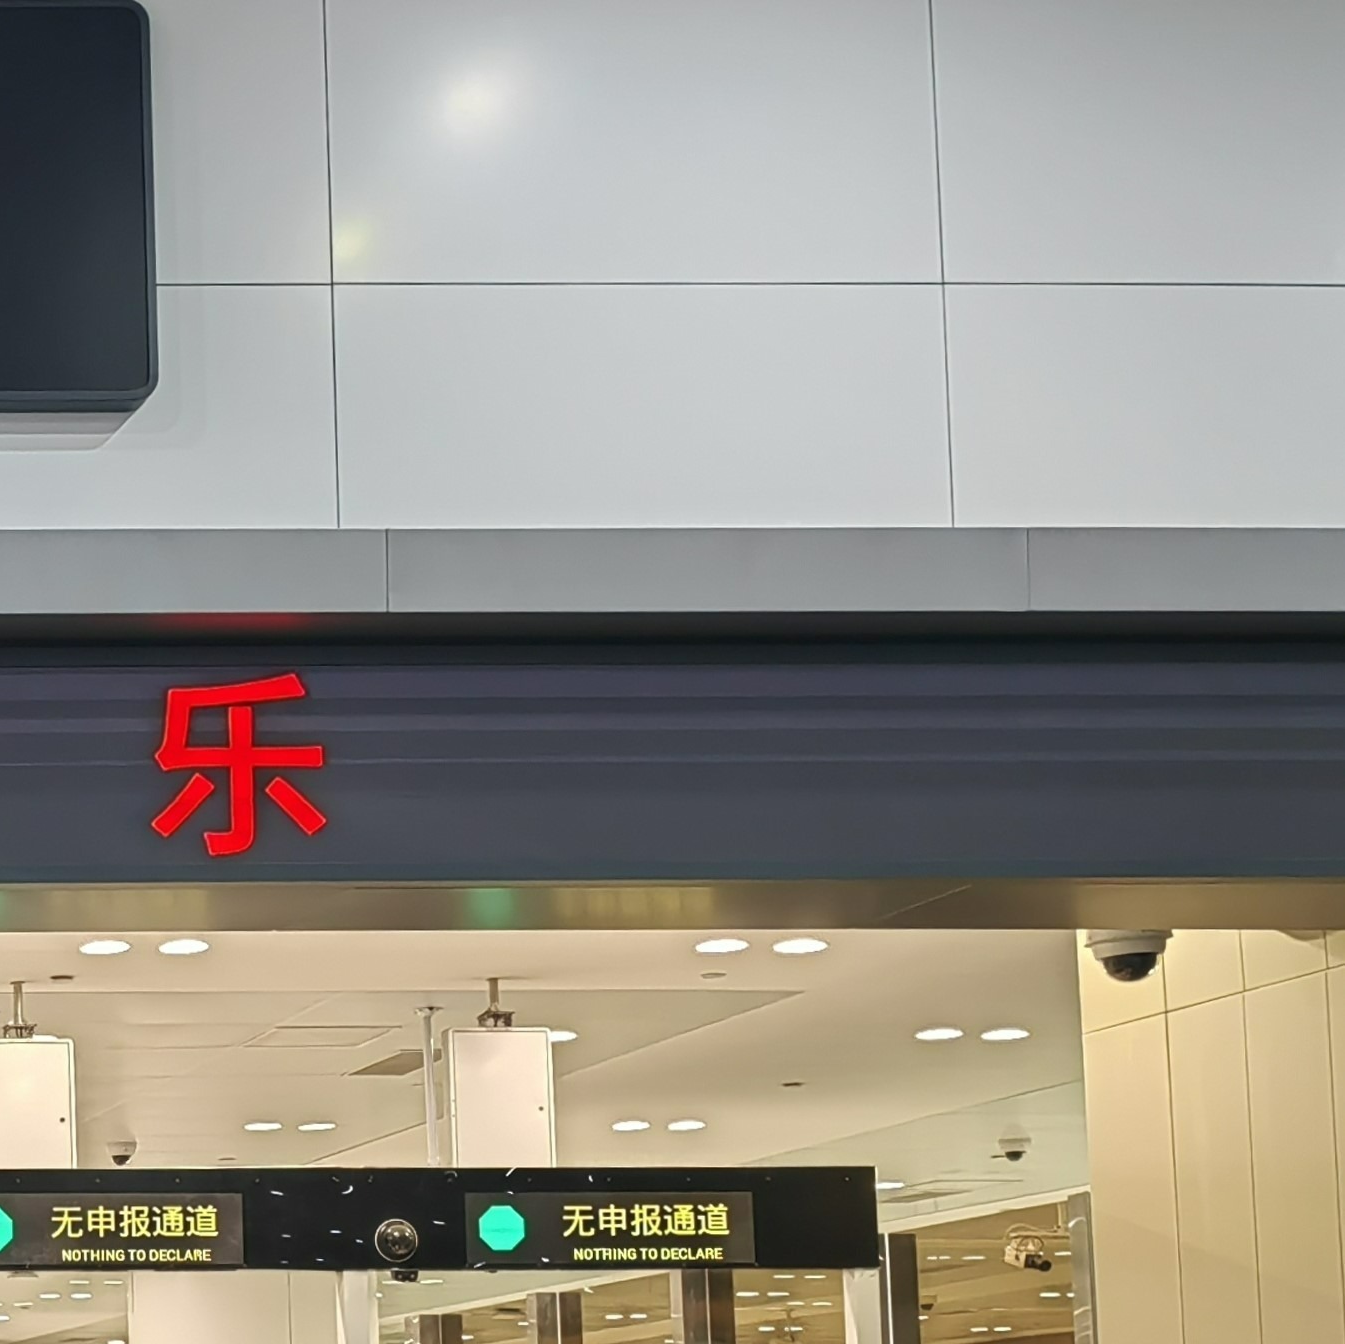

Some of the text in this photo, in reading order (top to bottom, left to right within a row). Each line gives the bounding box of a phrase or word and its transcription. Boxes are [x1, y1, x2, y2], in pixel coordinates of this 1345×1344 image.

[51, 1205, 219, 1239] 无申报通道
[563, 1203, 730, 1237] 无申报通道
[62, 1249, 211, 1262] NOTHING TO DECLARE
[573, 1247, 724, 1261] NOTHING TO DECLARE
